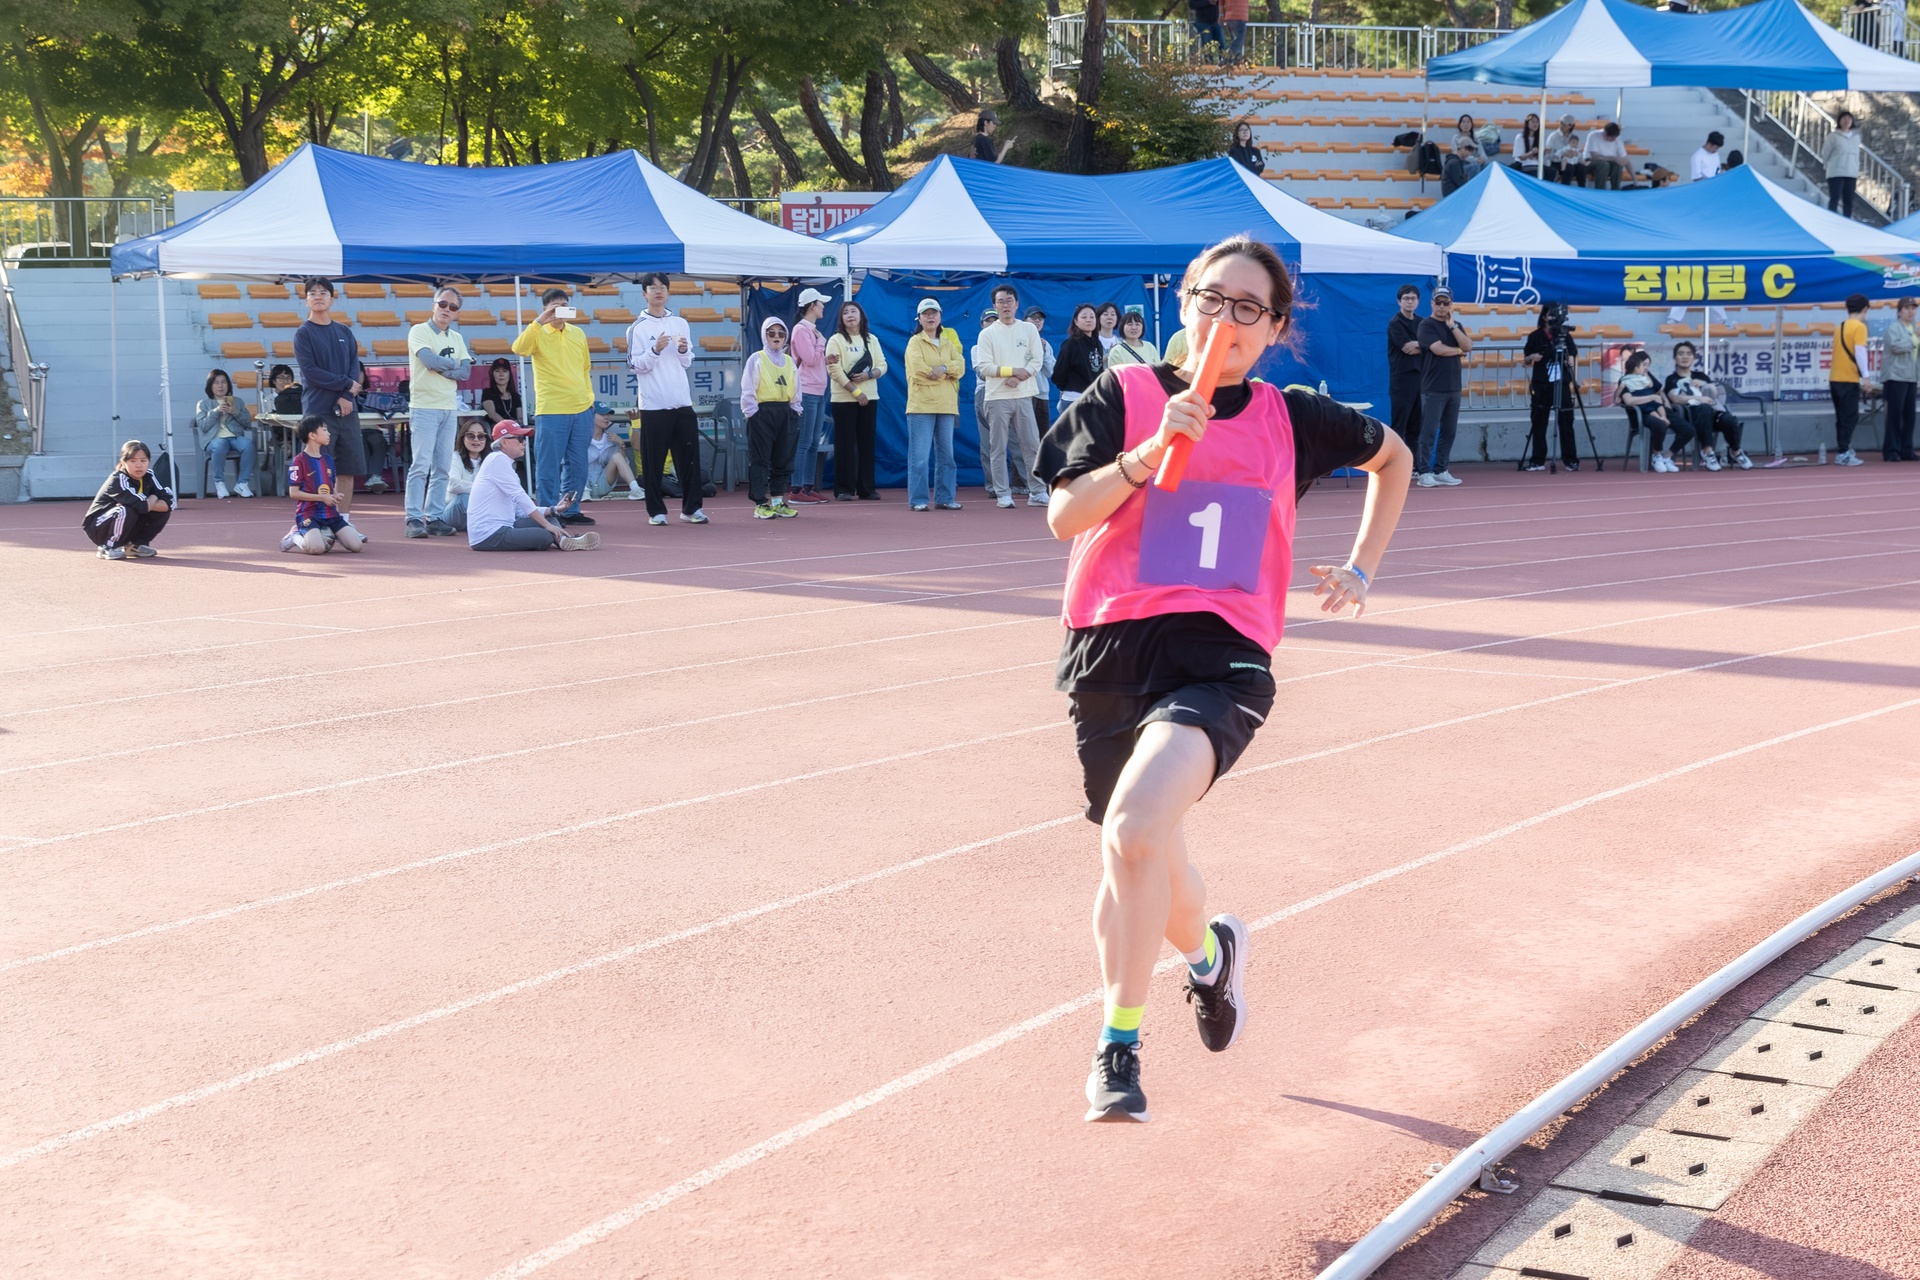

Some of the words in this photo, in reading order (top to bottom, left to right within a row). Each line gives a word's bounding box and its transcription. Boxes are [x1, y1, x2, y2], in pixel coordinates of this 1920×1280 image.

[1623, 264, 1747, 301] 준비팀
[1762, 263, 1797, 299] C
[1188, 502, 1222, 569] 1
